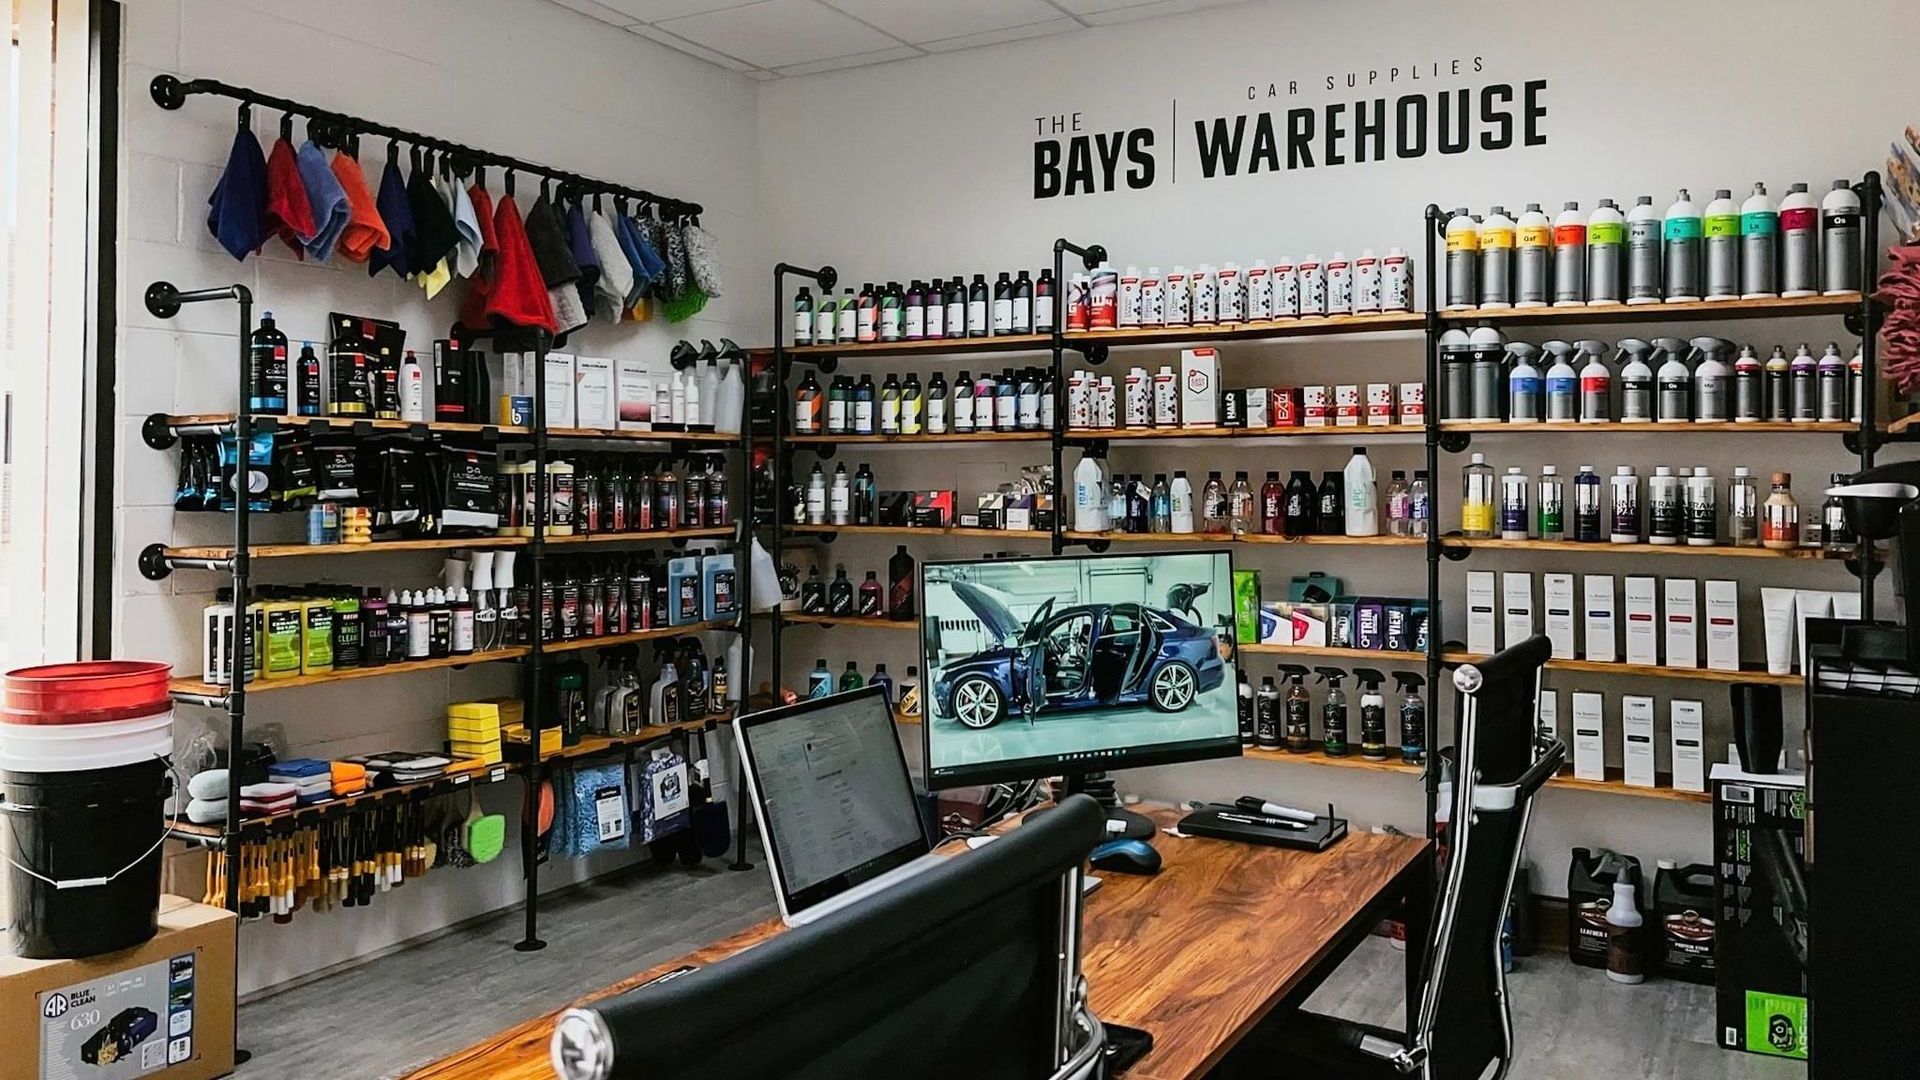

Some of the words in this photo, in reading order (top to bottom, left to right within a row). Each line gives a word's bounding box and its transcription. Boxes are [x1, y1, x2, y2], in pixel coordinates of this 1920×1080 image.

[1247, 79, 1298, 101] CAR
[1326, 55, 1485, 92] SUPPLIES
[1035, 111, 1083, 137] THE
[1194, 79, 1549, 179] WAREHOUSE
[1033, 127, 1156, 200] BAYS
[1225, 392, 1237, 419] HALO
[44, 993, 68, 1018] AR
[70, 989, 90, 1000] BLUE
[70, 995, 96, 1008] CLEAN
[70, 1008, 101, 1031] 630
